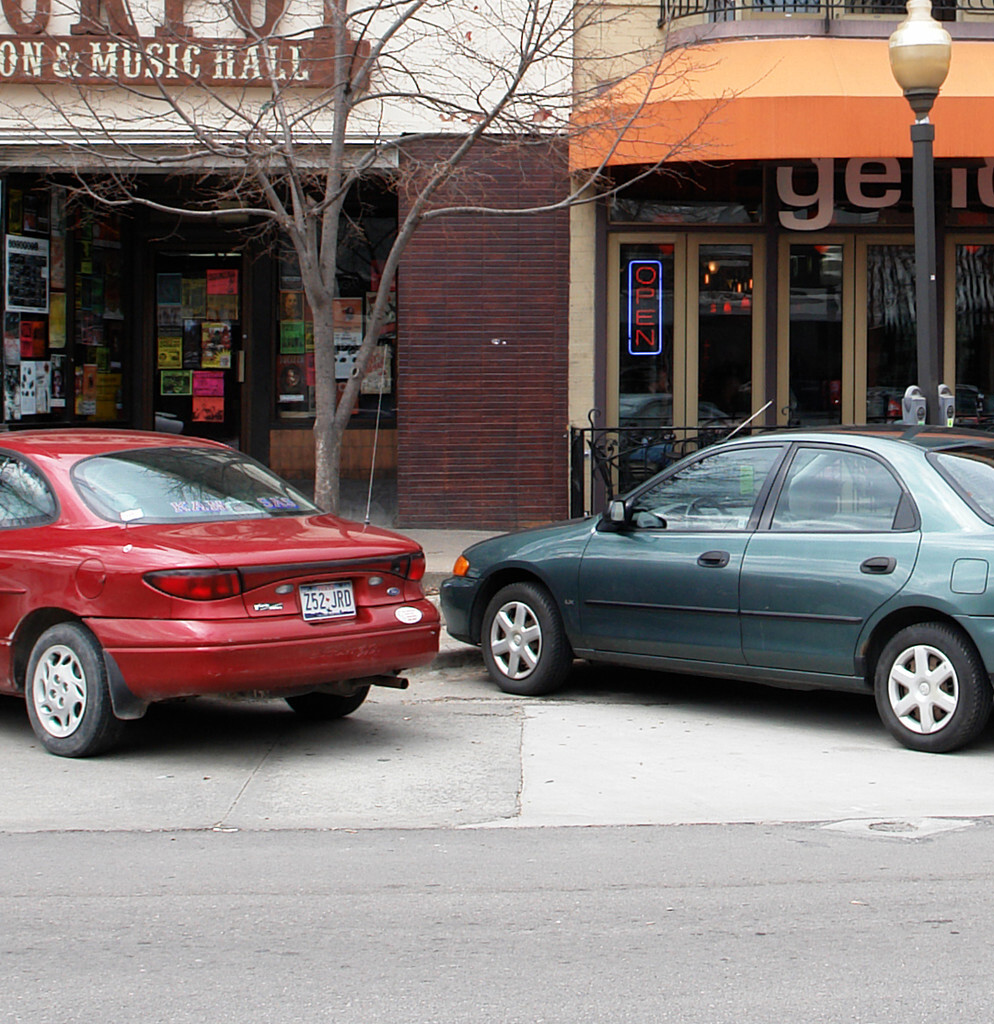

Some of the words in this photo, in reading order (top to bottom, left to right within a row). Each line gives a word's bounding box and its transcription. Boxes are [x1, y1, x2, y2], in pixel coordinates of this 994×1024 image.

[0, 40, 45, 77] ON
[52, 41, 82, 78] &
[90, 42, 201, 79] MUSIC
[212, 44, 310, 81] HALL
[635, 266, 656, 346] OPEN
